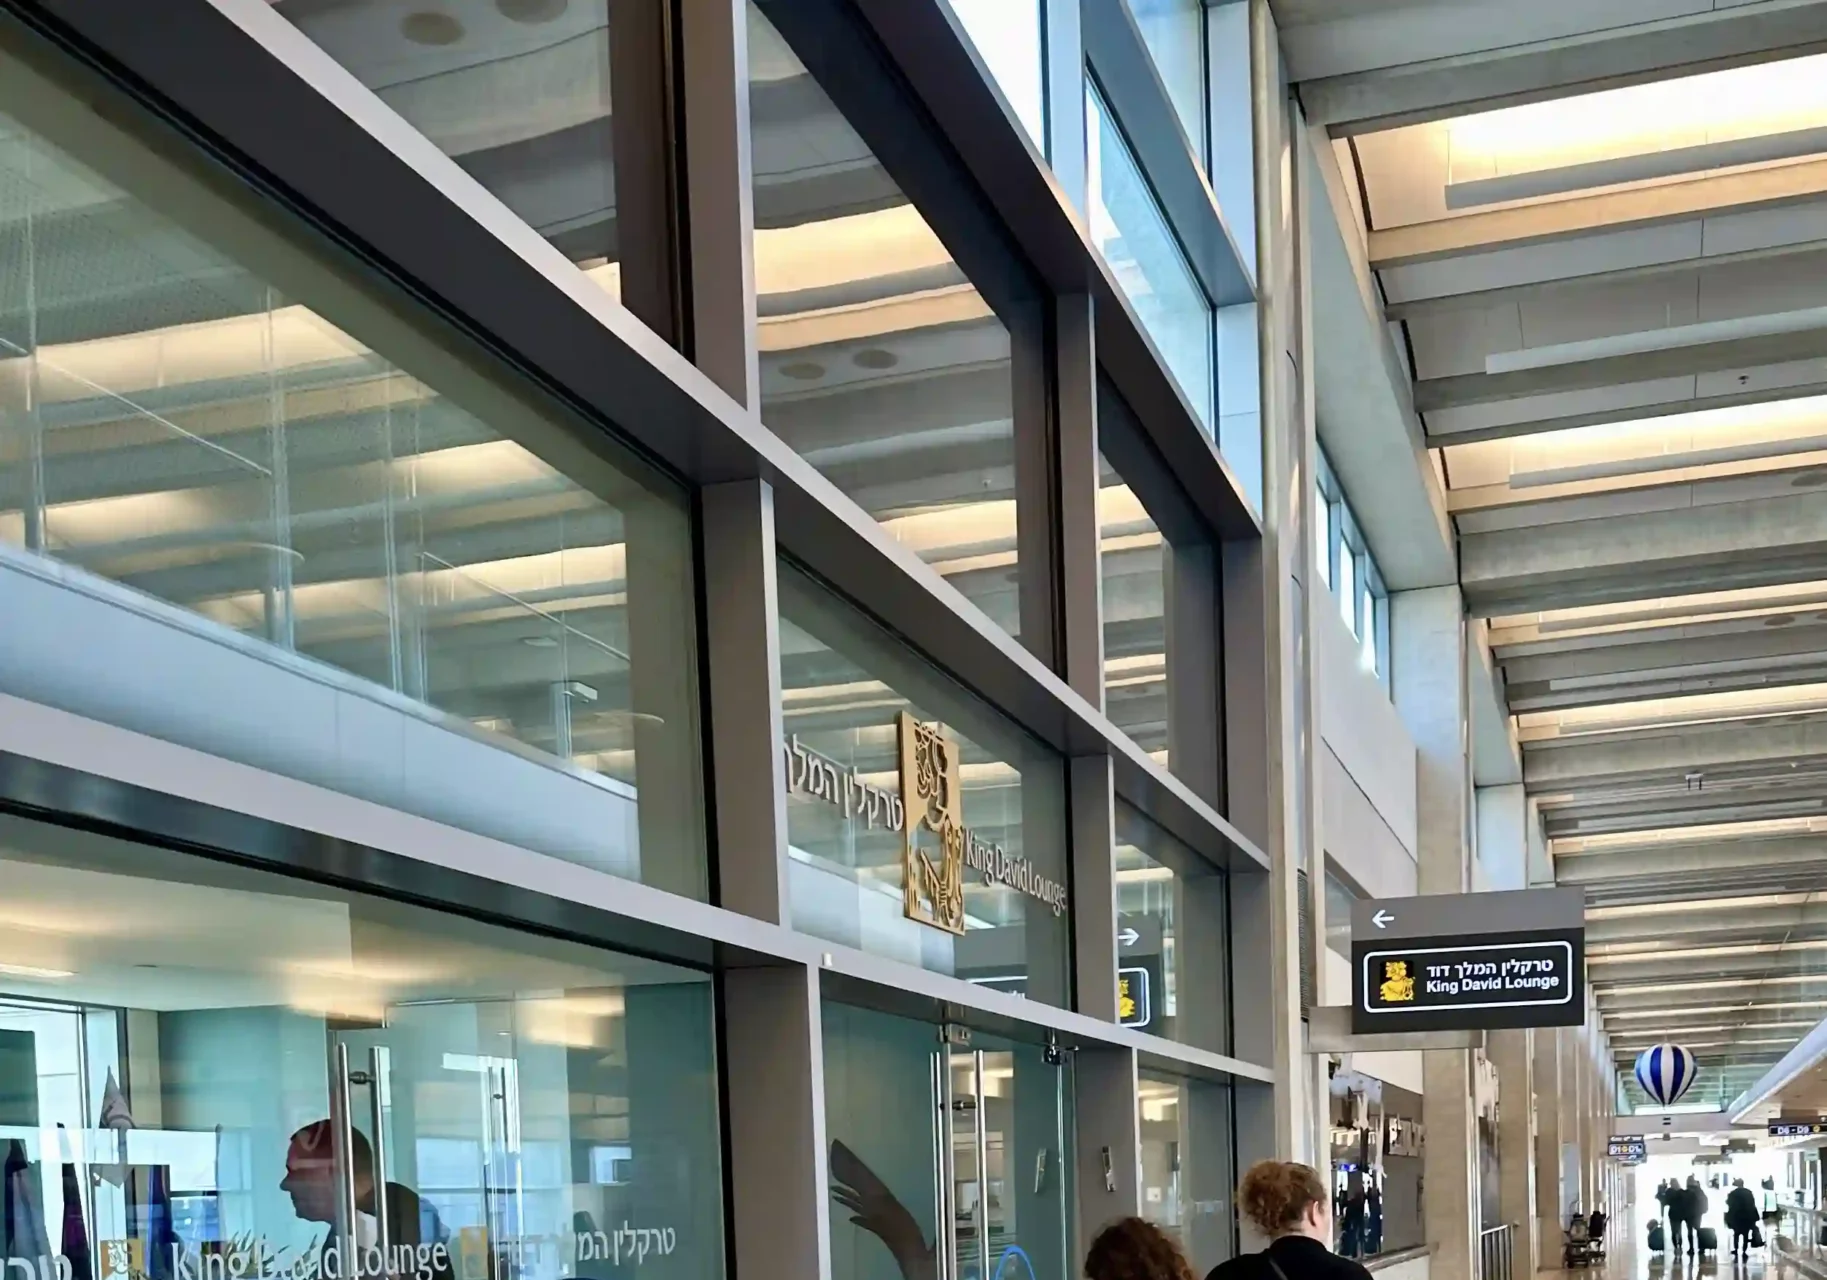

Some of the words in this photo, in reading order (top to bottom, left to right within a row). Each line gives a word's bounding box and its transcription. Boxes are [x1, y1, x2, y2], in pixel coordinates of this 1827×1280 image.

[843, 766, 904, 832] טרקלין
[966, 828, 995, 887] King
[995, 844, 1028, 892] David
[1029, 861, 1068, 917] Lounge
[1426, 964, 1451, 978] דוד
[1454, 961, 1497, 979] המלך
[1501, 958, 1554, 977] טרקלין
[1426, 979, 1459, 995] King
[1462, 976, 1502, 991] David
[1505, 976, 1560, 990] Lounge
[612, 1220, 676, 1266] טרקלין
